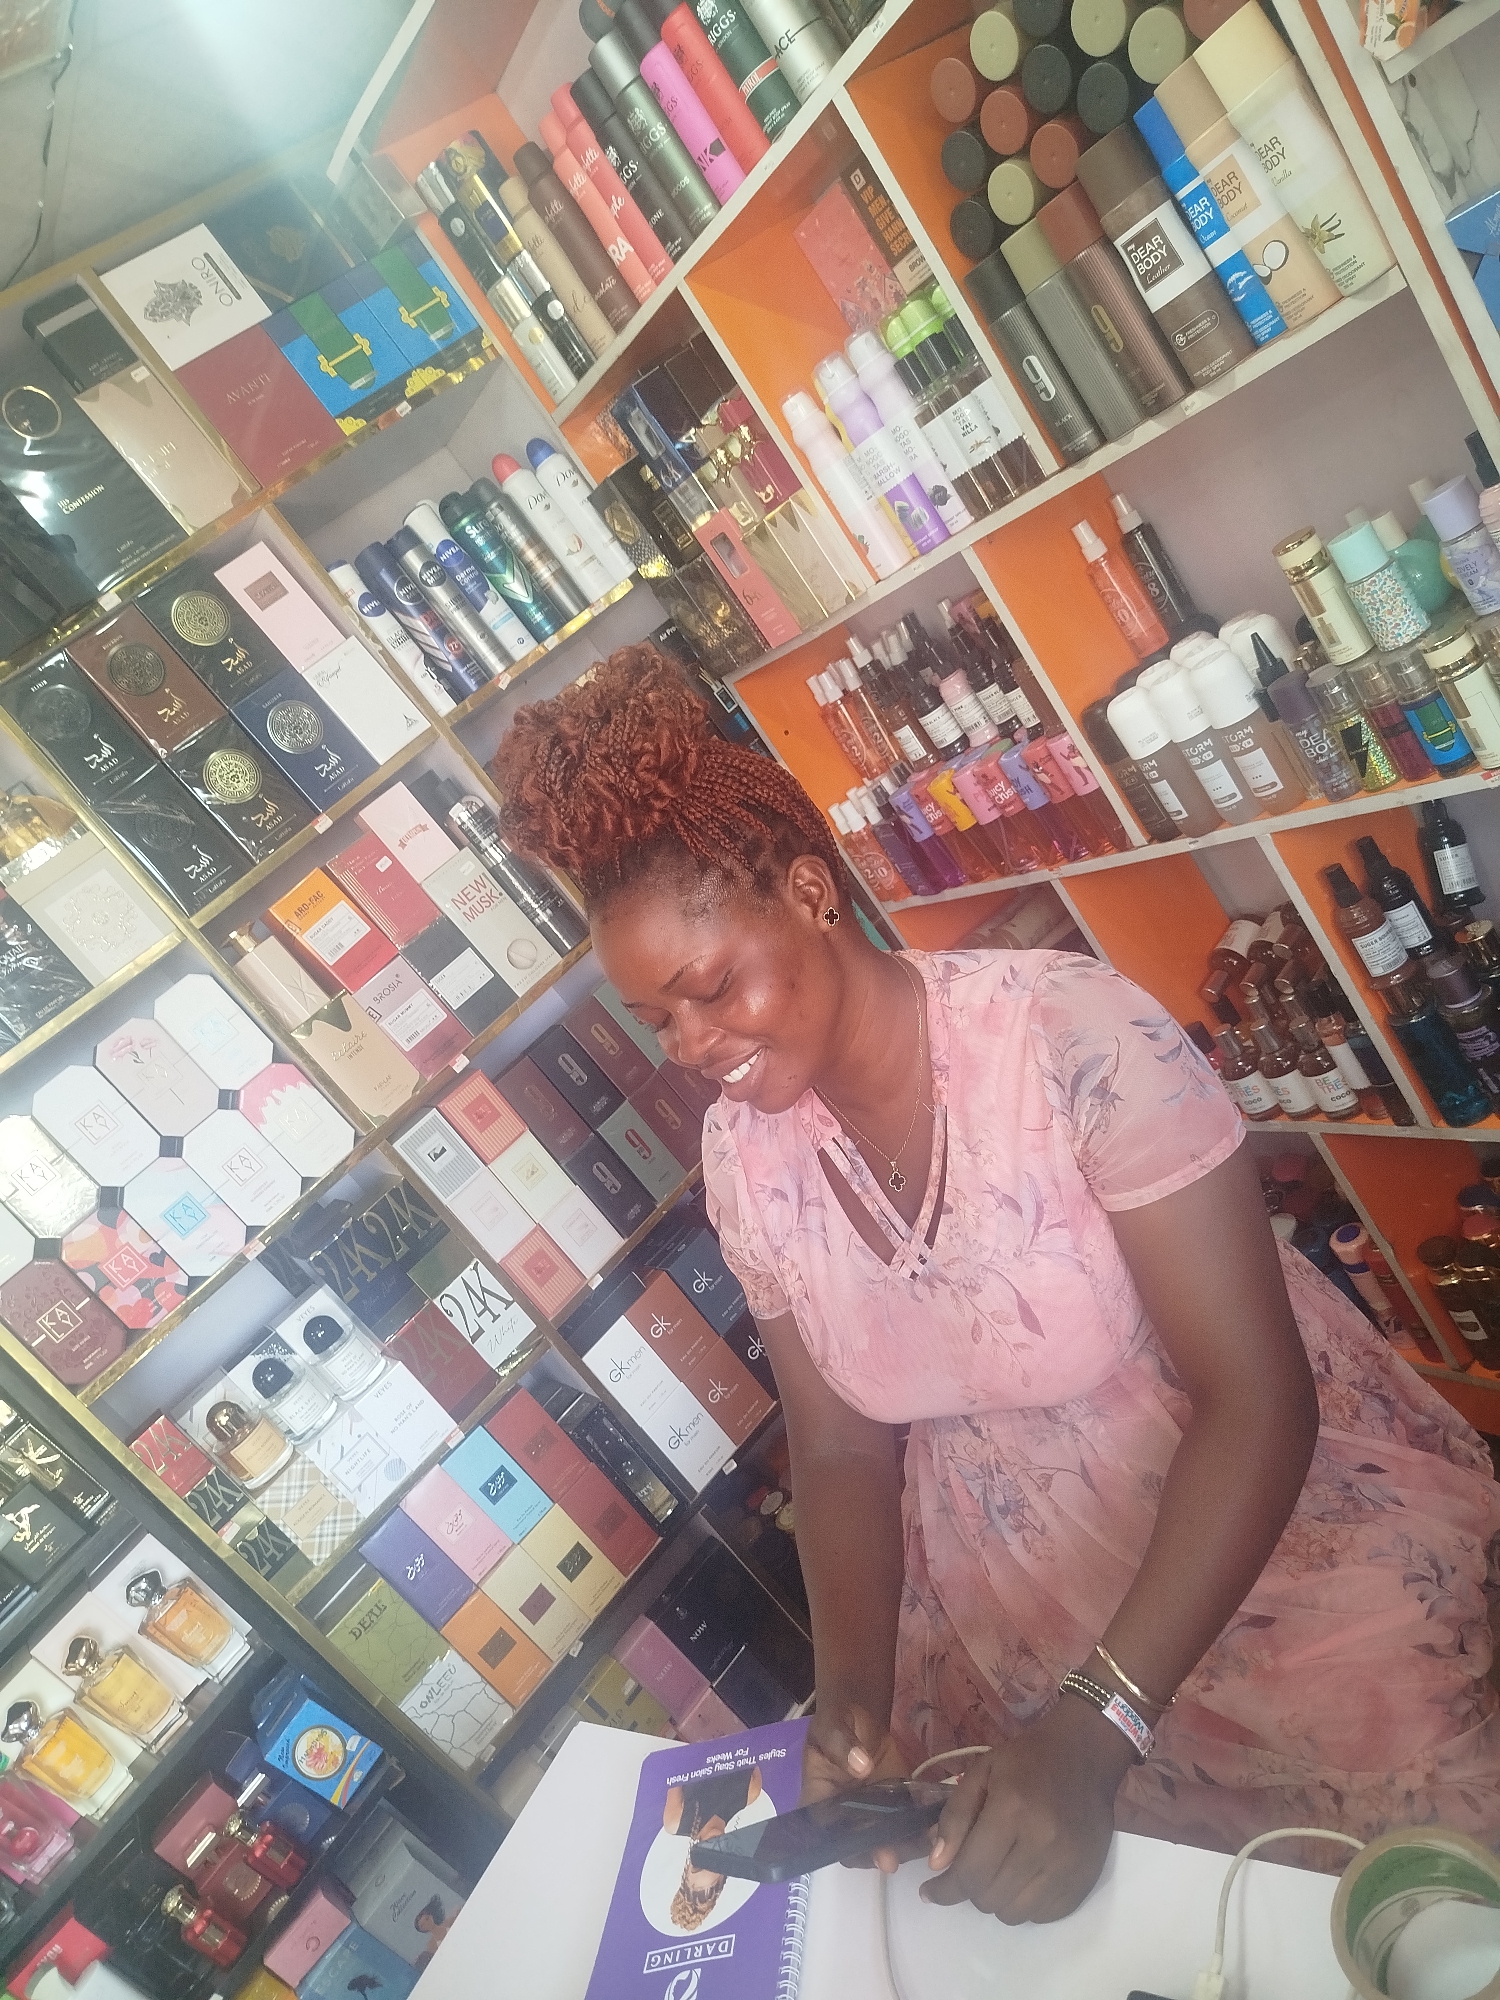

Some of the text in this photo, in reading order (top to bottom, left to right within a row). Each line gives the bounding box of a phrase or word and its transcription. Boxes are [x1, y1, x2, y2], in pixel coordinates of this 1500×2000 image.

[860, 185, 875, 204] VIP
[875, 207, 896, 232] GIVE
[1131, 234, 1163, 265] DEAR
[1137, 244, 1168, 276] BODY
[191, 256, 233, 307] ONIRO
[1146, 262, 1172, 285] Leather
[62, 484, 105, 516] CONFESSION
[100, 756, 120, 774] ASAD
[328, 765, 346, 782] ASAD
[265, 814, 284, 832] ASAD
[199, 866, 218, 884] ASAD
[451, 874, 489, 911] NEW
[462, 888, 499, 924] MUSK
[1330, 1090, 1351, 1103] COCO
[363, 1180, 440, 1262] 24K
[309, 1224, 393, 1304] 24K
[296, 1305, 317, 1324] VEYES
[439, 1259, 515, 1345] 24K
[374, 1380, 394, 1400] VEYES
[130, 1416, 193, 1476] 24K
[344, 1447, 373, 1476] NIGHTLIFE
[348, 1599, 389, 1642] DEAL
[666, 1747, 787, 1786] Styles That Stay Salon Fresh
[706, 1747, 750, 1764] For Weeks
[650, 1939, 730, 1968] DARLING
